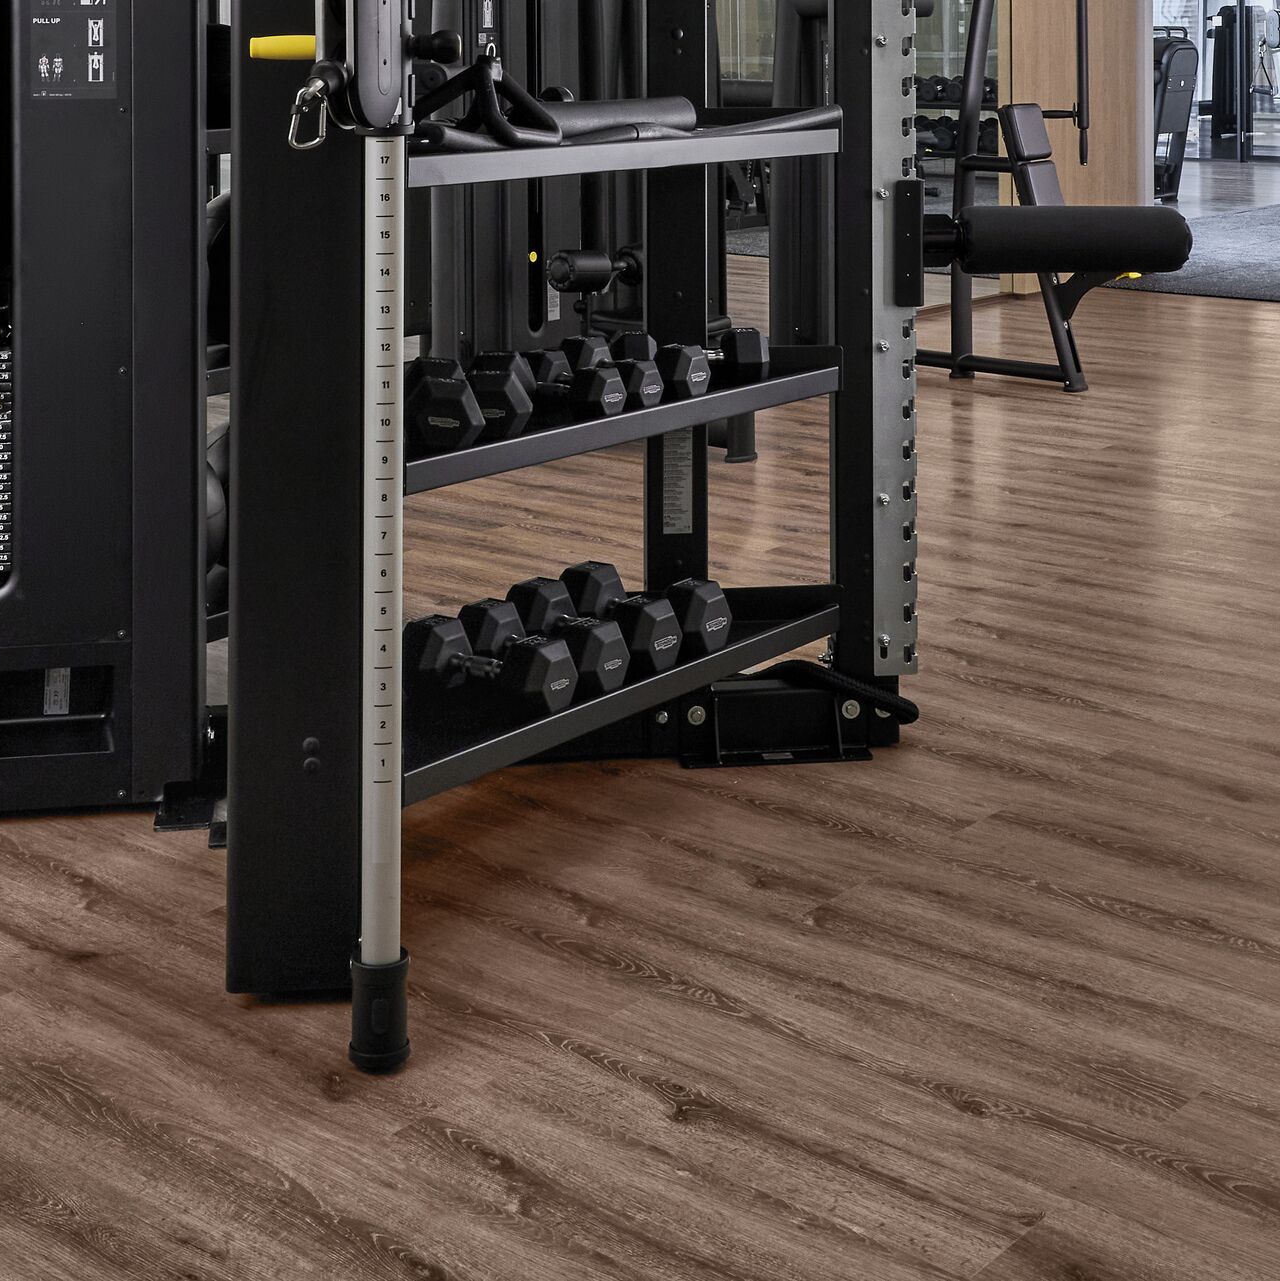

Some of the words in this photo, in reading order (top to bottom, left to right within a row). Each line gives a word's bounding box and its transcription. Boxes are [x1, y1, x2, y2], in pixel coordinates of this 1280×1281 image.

[381, 156, 389, 164] 17
[380, 193, 390, 201] 16
[380, 230, 390, 238] 15
[380, 268, 390, 276] 14
[381, 305, 390, 313] 13
[381, 343, 390, 351] 12
[382, 380, 389, 388] 11
[380, 418, 390, 426] 10
[382, 456, 388, 464] 9
[381, 494, 387, 502] 8
[381, 531, 387, 539] 7
[380, 569, 387, 577] 6
[380, 607, 386, 615] 5
[380, 644, 387, 652] 4
[380, 683, 386, 691] 3
[380, 721, 386, 729] 2
[380, 759, 385, 767] 1
